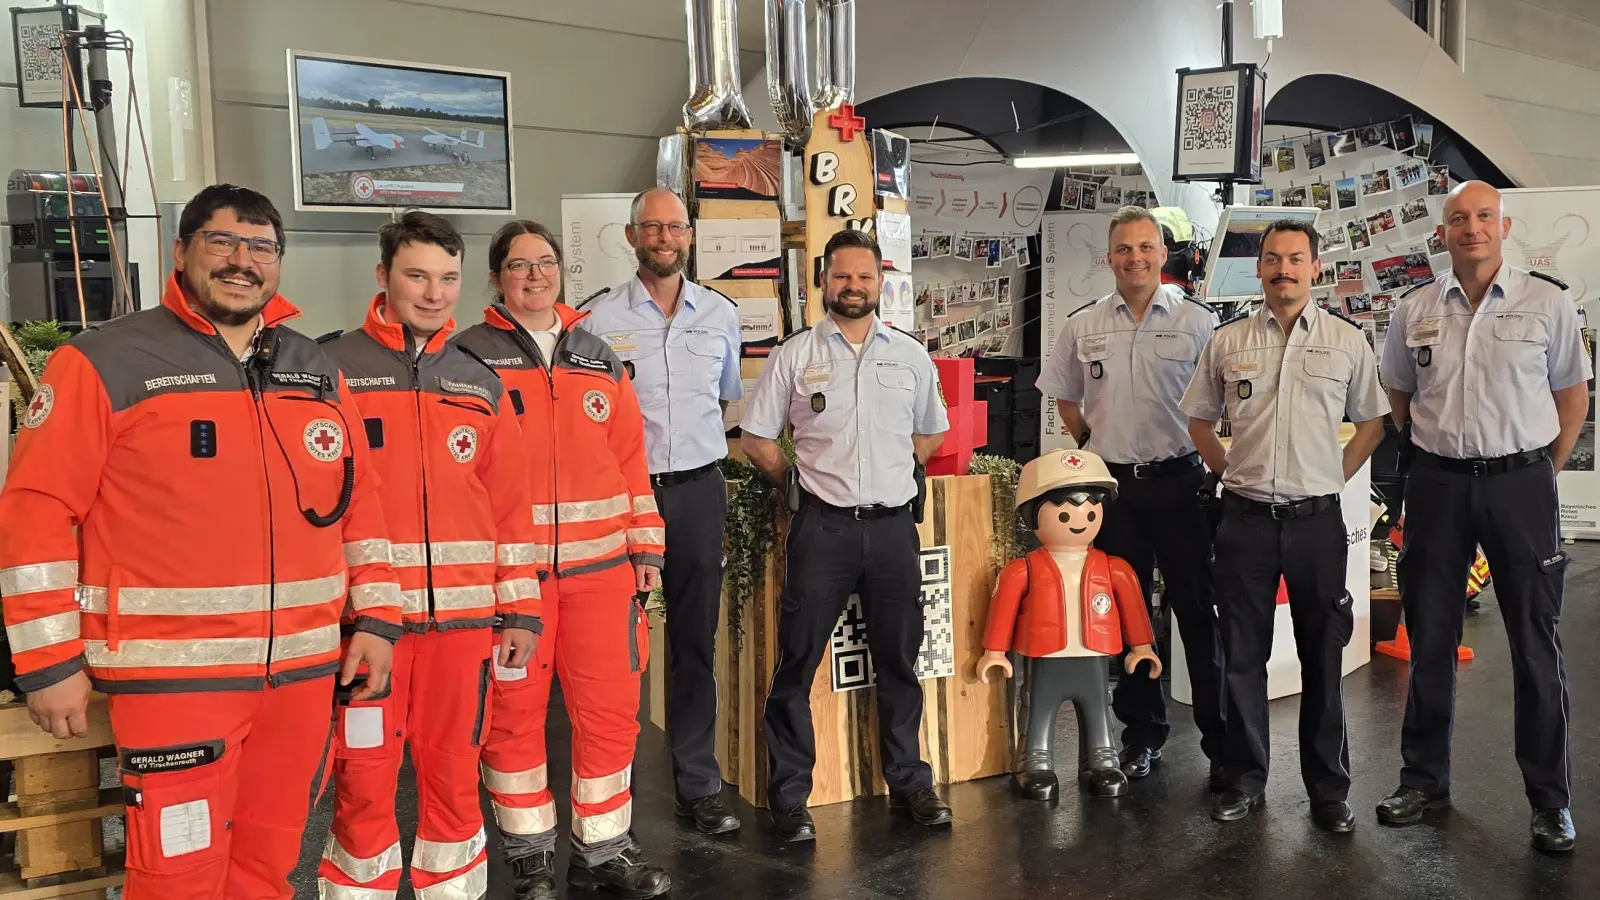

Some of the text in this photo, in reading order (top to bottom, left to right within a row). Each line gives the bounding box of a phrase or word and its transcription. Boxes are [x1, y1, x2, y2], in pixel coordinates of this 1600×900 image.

[570, 221, 586, 274] System
[1045, 222, 1057, 263] System
[1529, 259, 1550, 267] UAS
[1045, 267, 1056, 299] Aerial
[1045, 303, 1056, 361] nmanned
[144, 373, 217, 391] BEREITSCHAFTEN
[306, 421, 340, 437] DEUTSCHES
[131, 749, 205, 765] GERALD WAGNER
